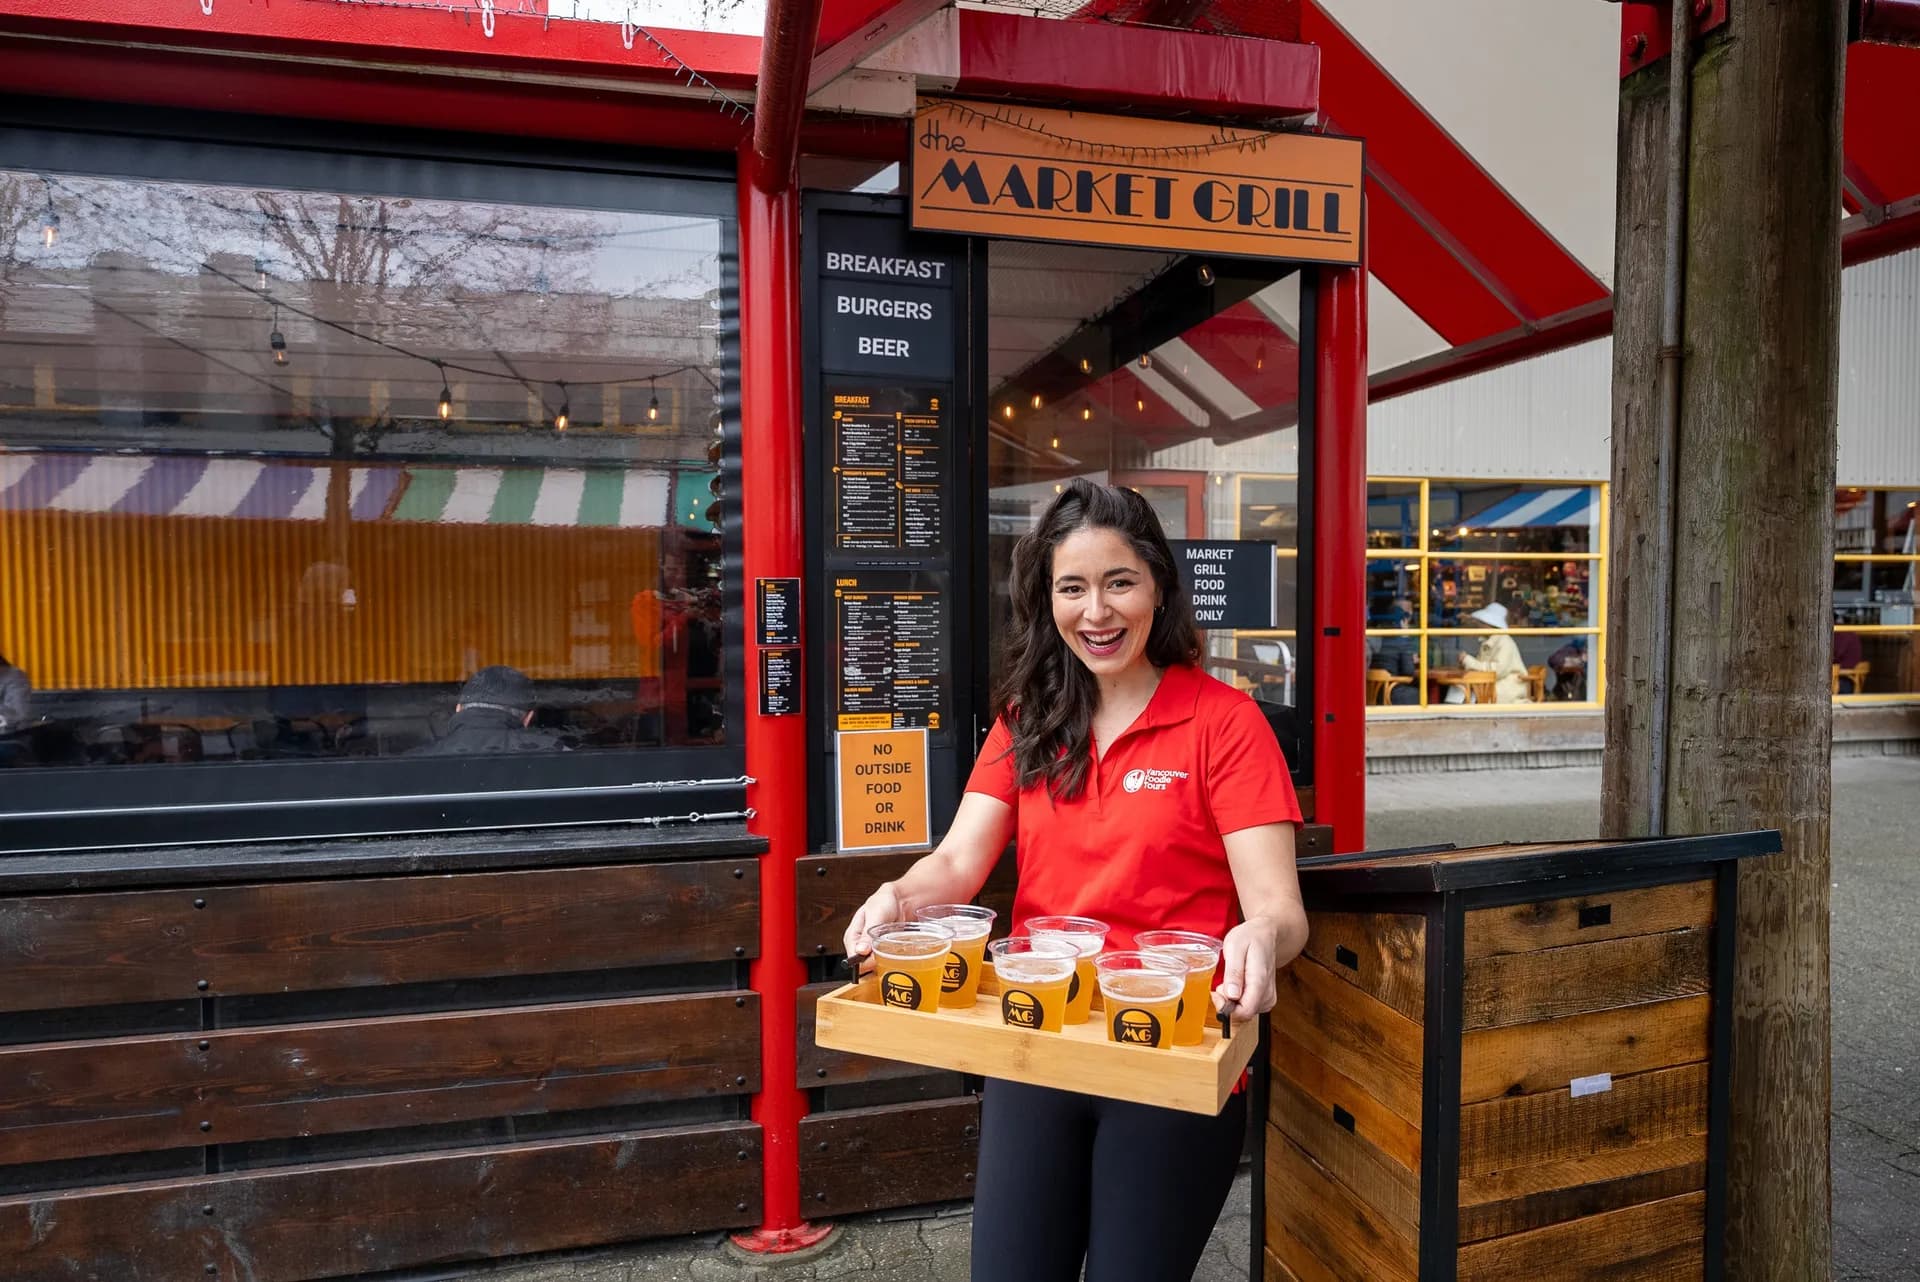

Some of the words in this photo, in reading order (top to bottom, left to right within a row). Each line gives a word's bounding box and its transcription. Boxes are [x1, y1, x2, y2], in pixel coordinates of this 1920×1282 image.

[920, 119, 966, 152] the
[921, 158, 1179, 220] MARKET
[1193, 180, 1352, 234] GRILL
[826, 252, 946, 280] BREAKFAST
[837, 295, 933, 320] BURGERS
[858, 336, 910, 358] BEER
[834, 395, 870, 404] BREAKFAST
[1186, 548, 1234, 560] MARKET
[1194, 564, 1226, 575] GRILL
[836, 578, 857, 587] LUNCH
[1194, 579, 1225, 590] FOOD
[1192, 594, 1227, 606] DRINK
[1195, 609, 1225, 621] ONLY
[873, 744, 893, 756] NO
[855, 762, 912, 776] OUTSIDE
[866, 782, 902, 795] FOOD
[875, 802, 894, 813] OR
[865, 821, 906, 834] DRINK
[886, 988, 912, 1003] MG
[1007, 1007, 1034, 1023] MG
[1120, 1027, 1152, 1042] MG
